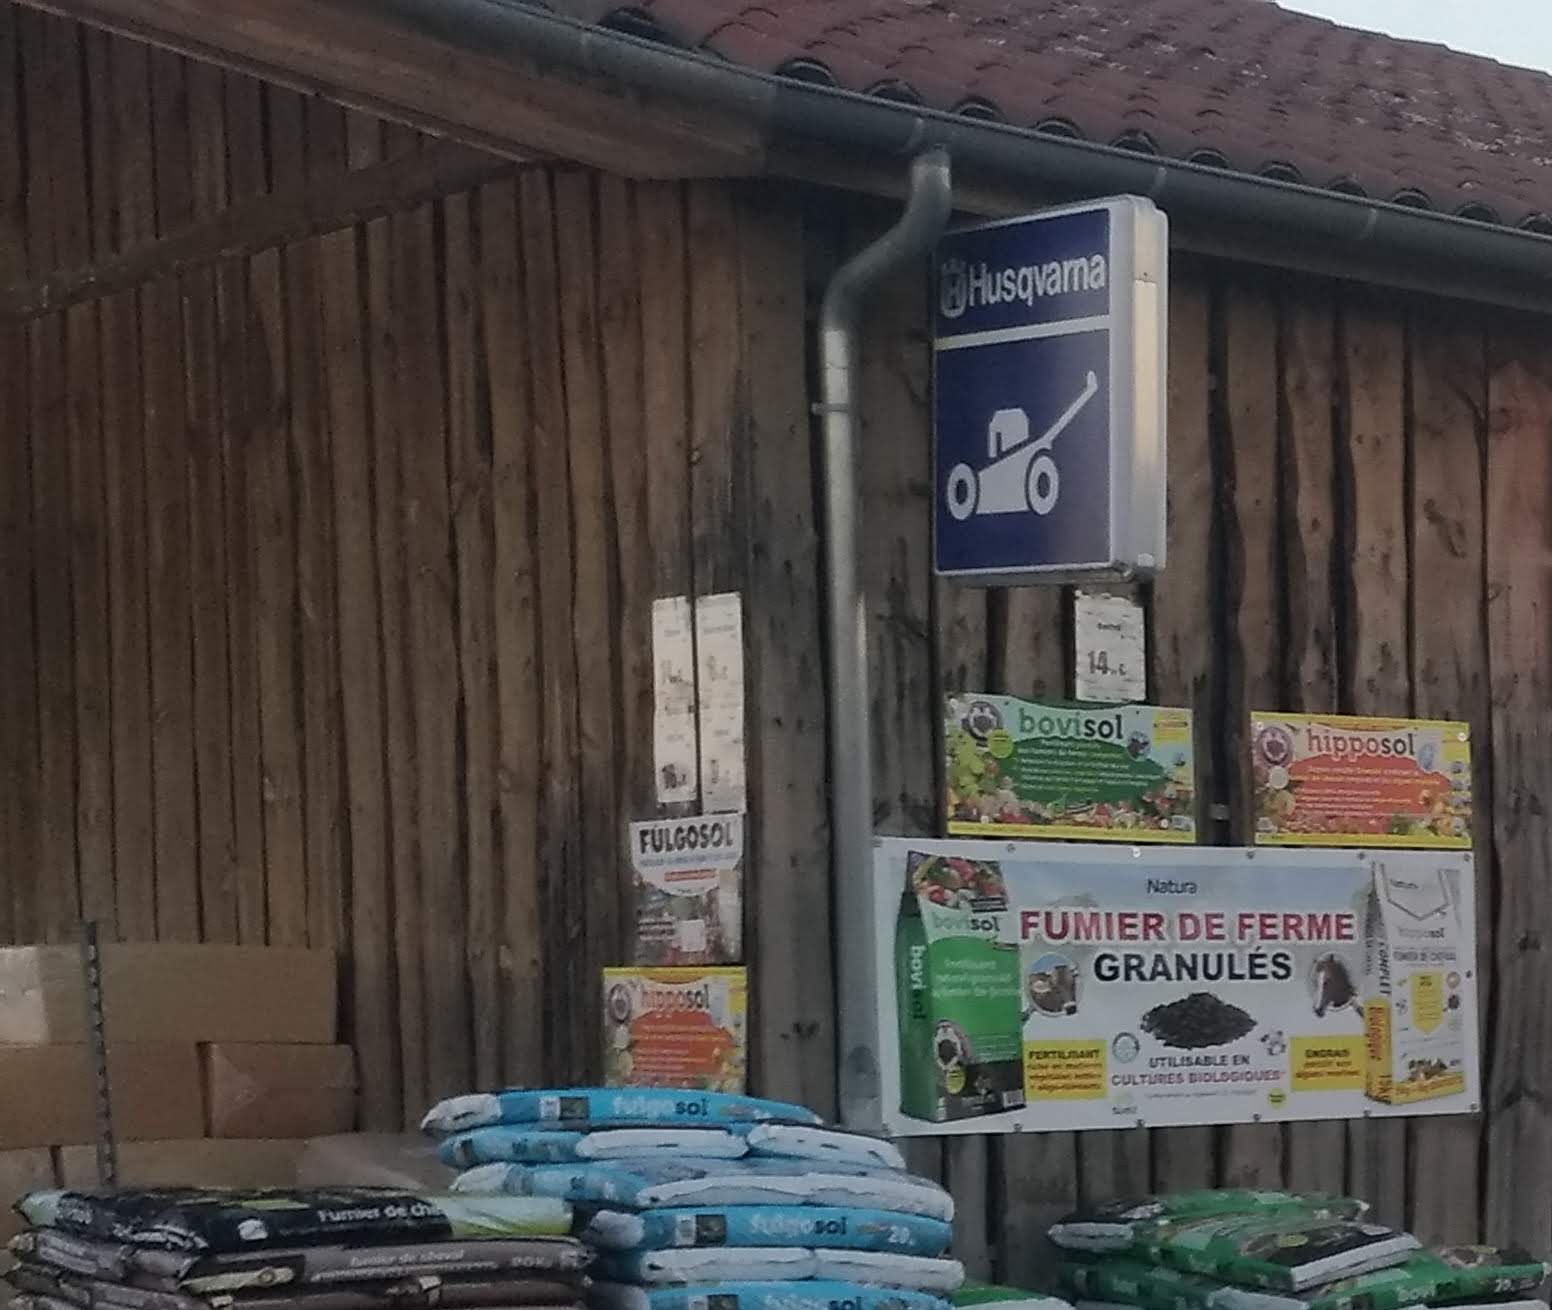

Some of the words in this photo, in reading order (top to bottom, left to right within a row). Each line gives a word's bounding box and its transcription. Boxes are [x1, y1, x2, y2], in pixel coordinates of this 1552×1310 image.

[968, 254, 1106, 306] Husqvarna
[1019, 708, 1123, 740] bovisol
[1307, 729, 1416, 763] hipposol
[639, 822, 734, 855] FULGOSOL
[1147, 879, 1197, 894] Natura
[1019, 910, 1164, 942] FUMIER
[1178, 912, 1226, 942] DE
[1237, 912, 1355, 942] FERME
[1093, 946, 1292, 982] GRANULÉS
[1149, 1055, 1228, 1069] UTILISABLE
[1232, 1054, 1250, 1066] EN
[1111, 1072, 1184, 1087] CULTURES
